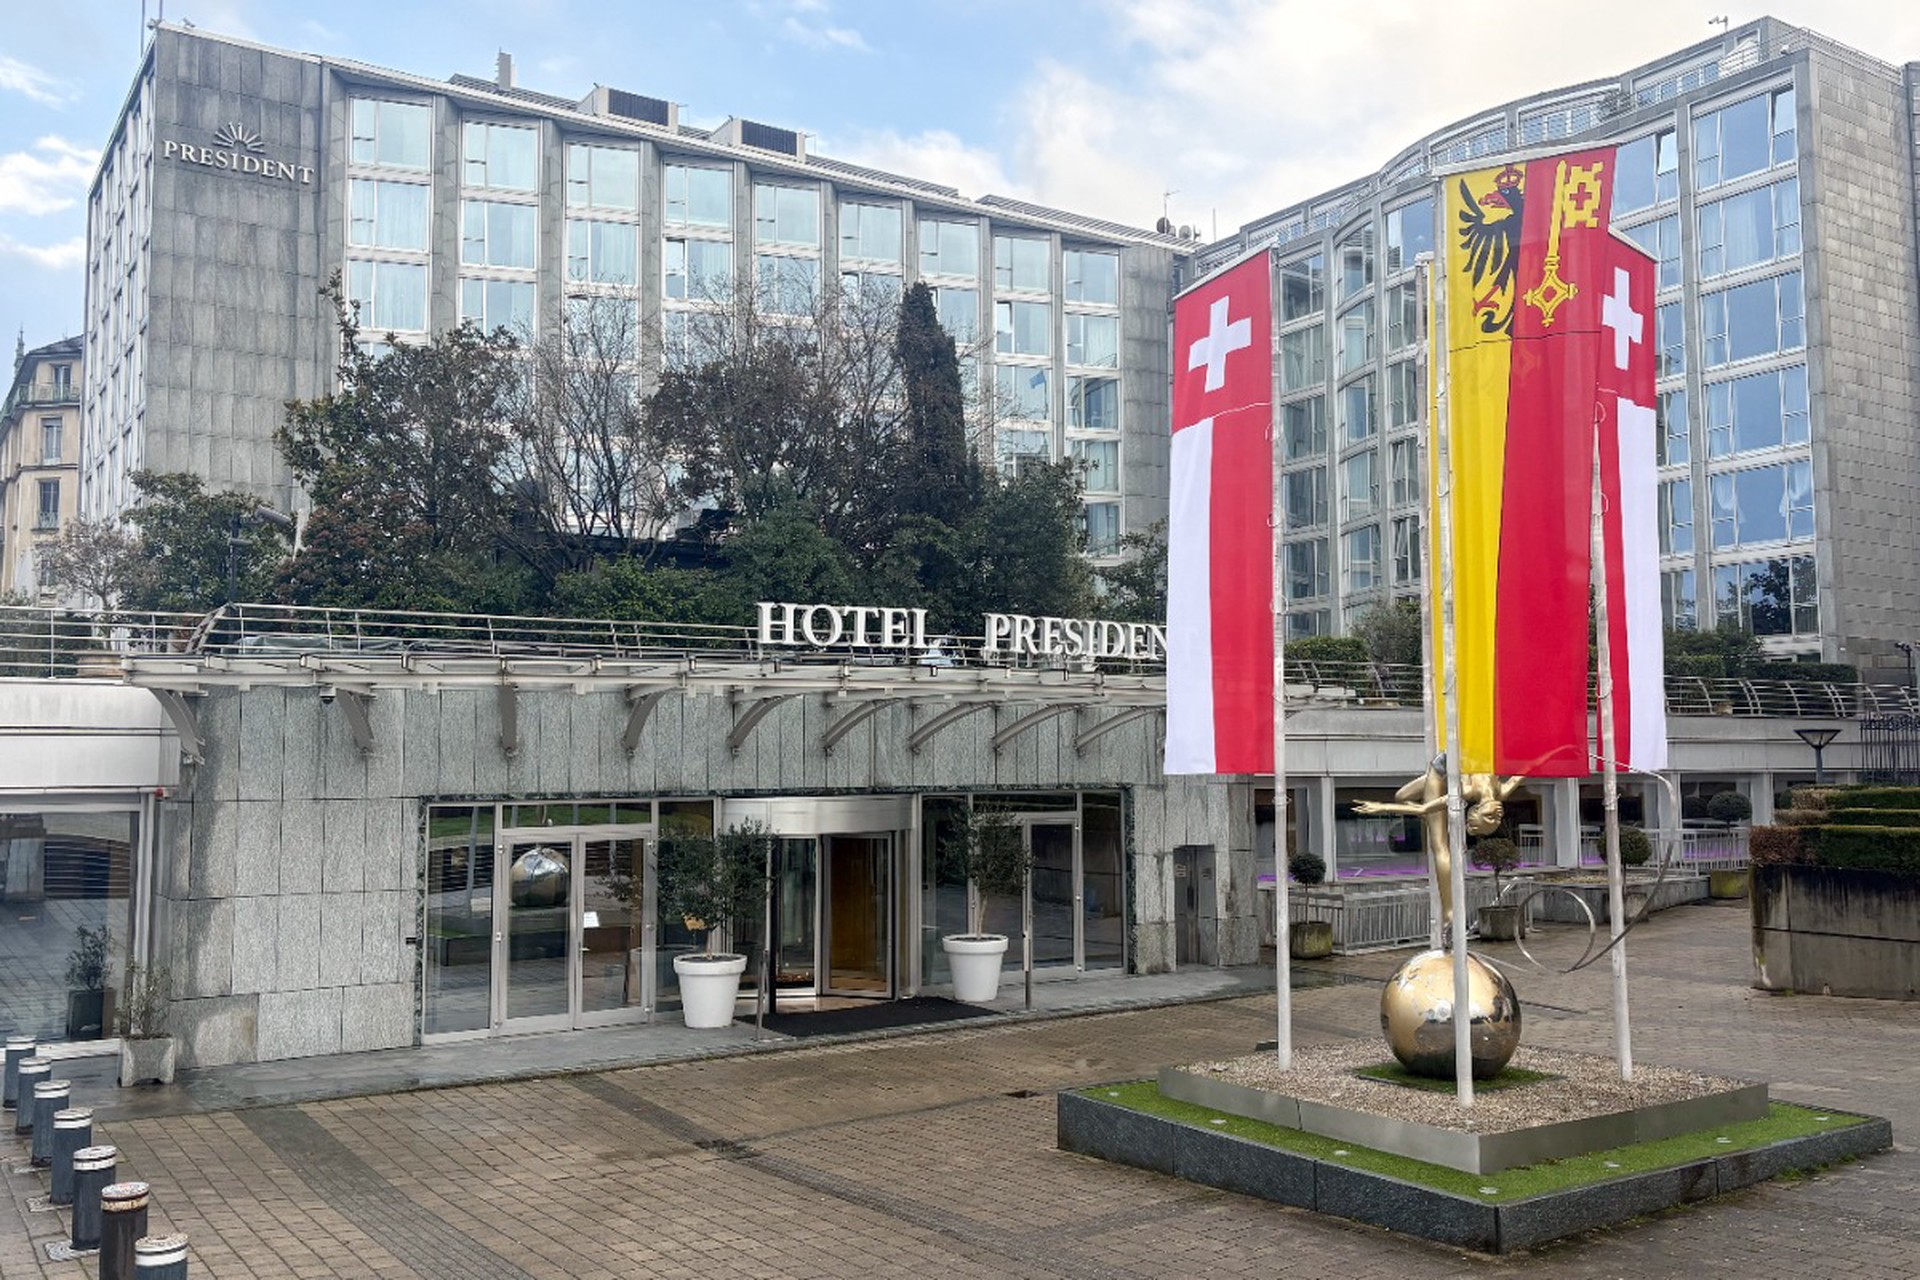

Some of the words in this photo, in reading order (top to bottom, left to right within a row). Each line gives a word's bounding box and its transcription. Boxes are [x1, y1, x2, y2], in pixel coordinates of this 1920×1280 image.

[162, 139, 315, 184] PRESIDENT
[755, 601, 941, 650] HOTEL
[982, 612, 1167, 660] PRESIDEN
